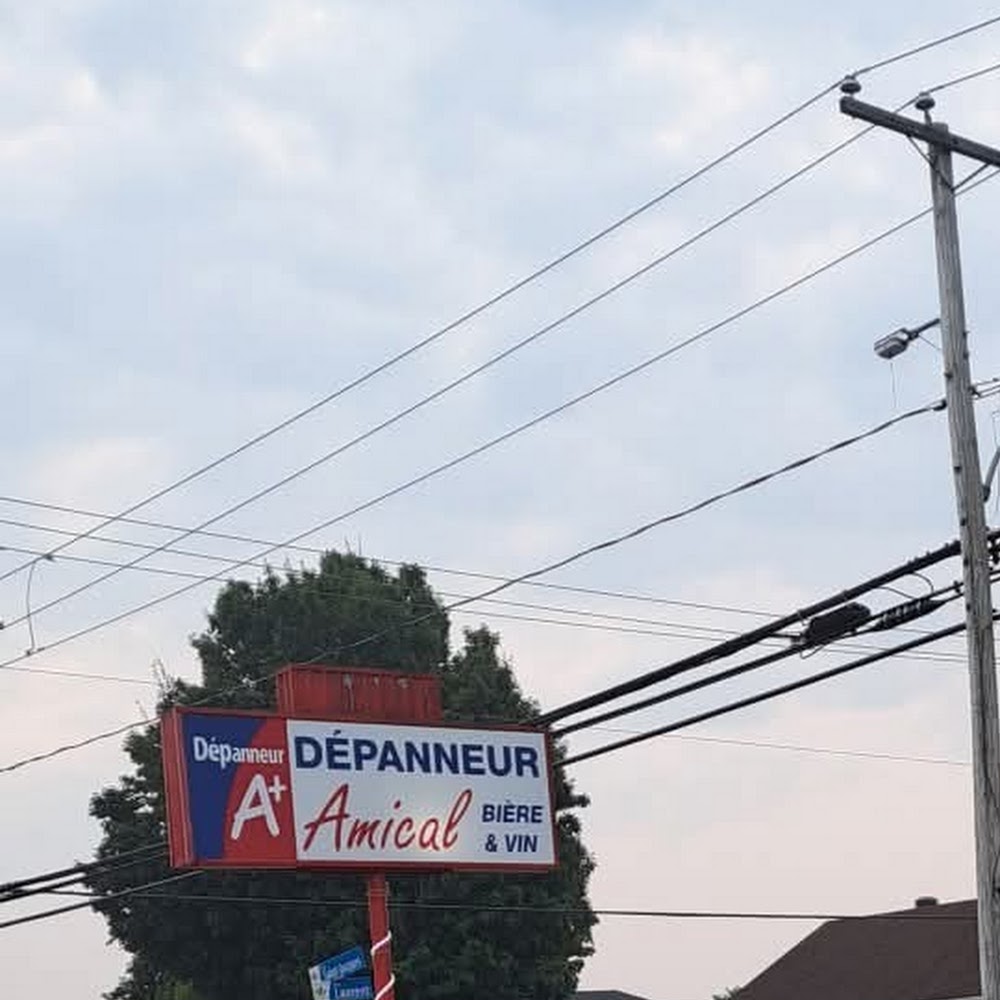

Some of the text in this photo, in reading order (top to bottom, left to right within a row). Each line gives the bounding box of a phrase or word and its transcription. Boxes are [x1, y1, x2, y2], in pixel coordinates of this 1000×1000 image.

[193, 736, 286, 768] Dépanneur
[295, 730, 540, 778] DÉPANNEUR
[303, 784, 473, 852] Amical
[482, 800, 543, 824] BIÈRE
[484, 835, 538, 853] & VIN
